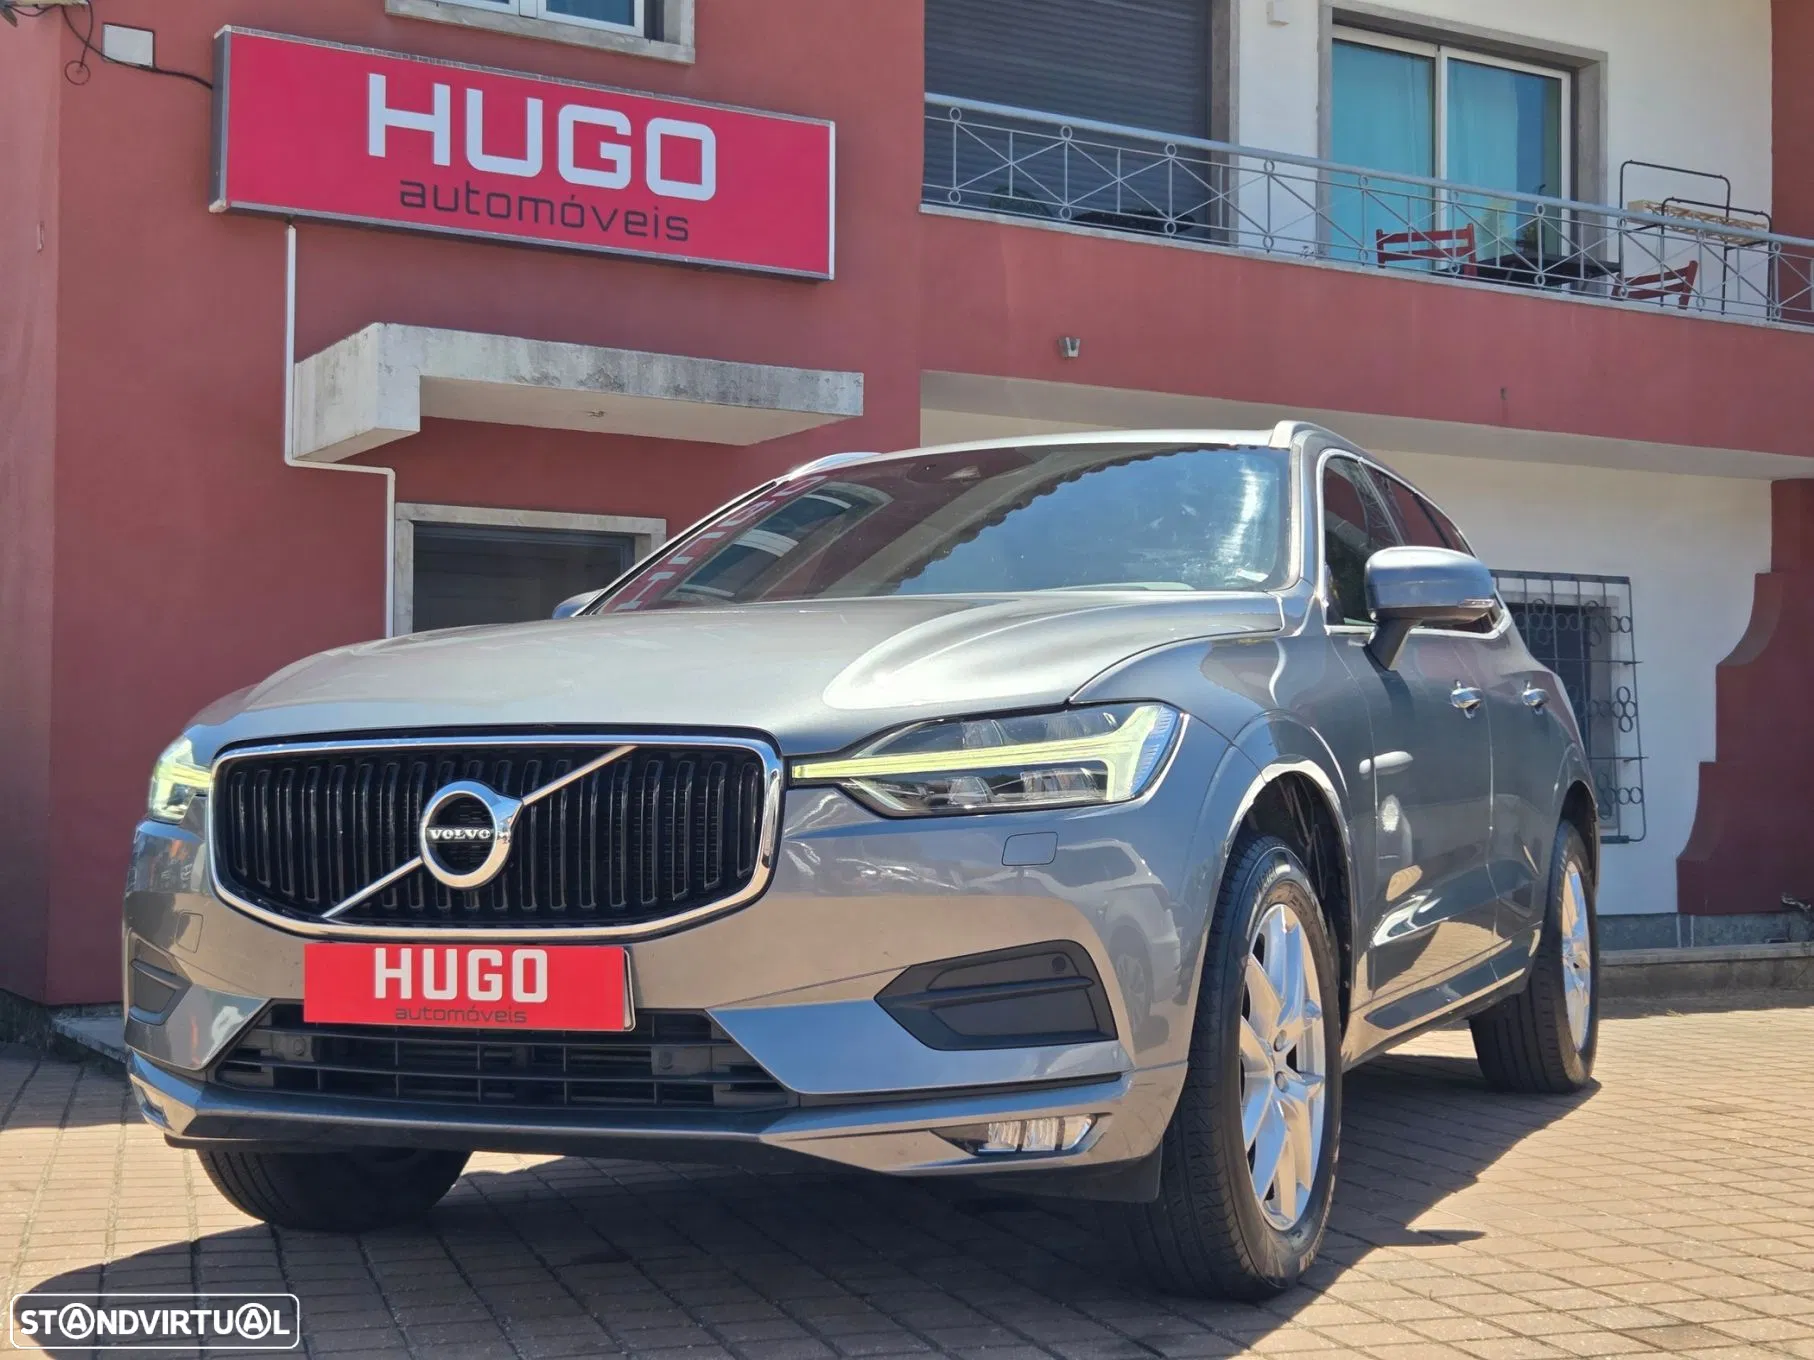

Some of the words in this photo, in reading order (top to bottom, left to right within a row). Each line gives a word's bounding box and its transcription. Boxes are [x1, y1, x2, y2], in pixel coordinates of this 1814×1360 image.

[367, 73, 717, 201] HUGO
[399, 179, 690, 242] automóveis
[429, 829, 491, 840] VOLVO
[374, 947, 548, 1003] HUGO
[395, 1005, 527, 1023] automóveis
